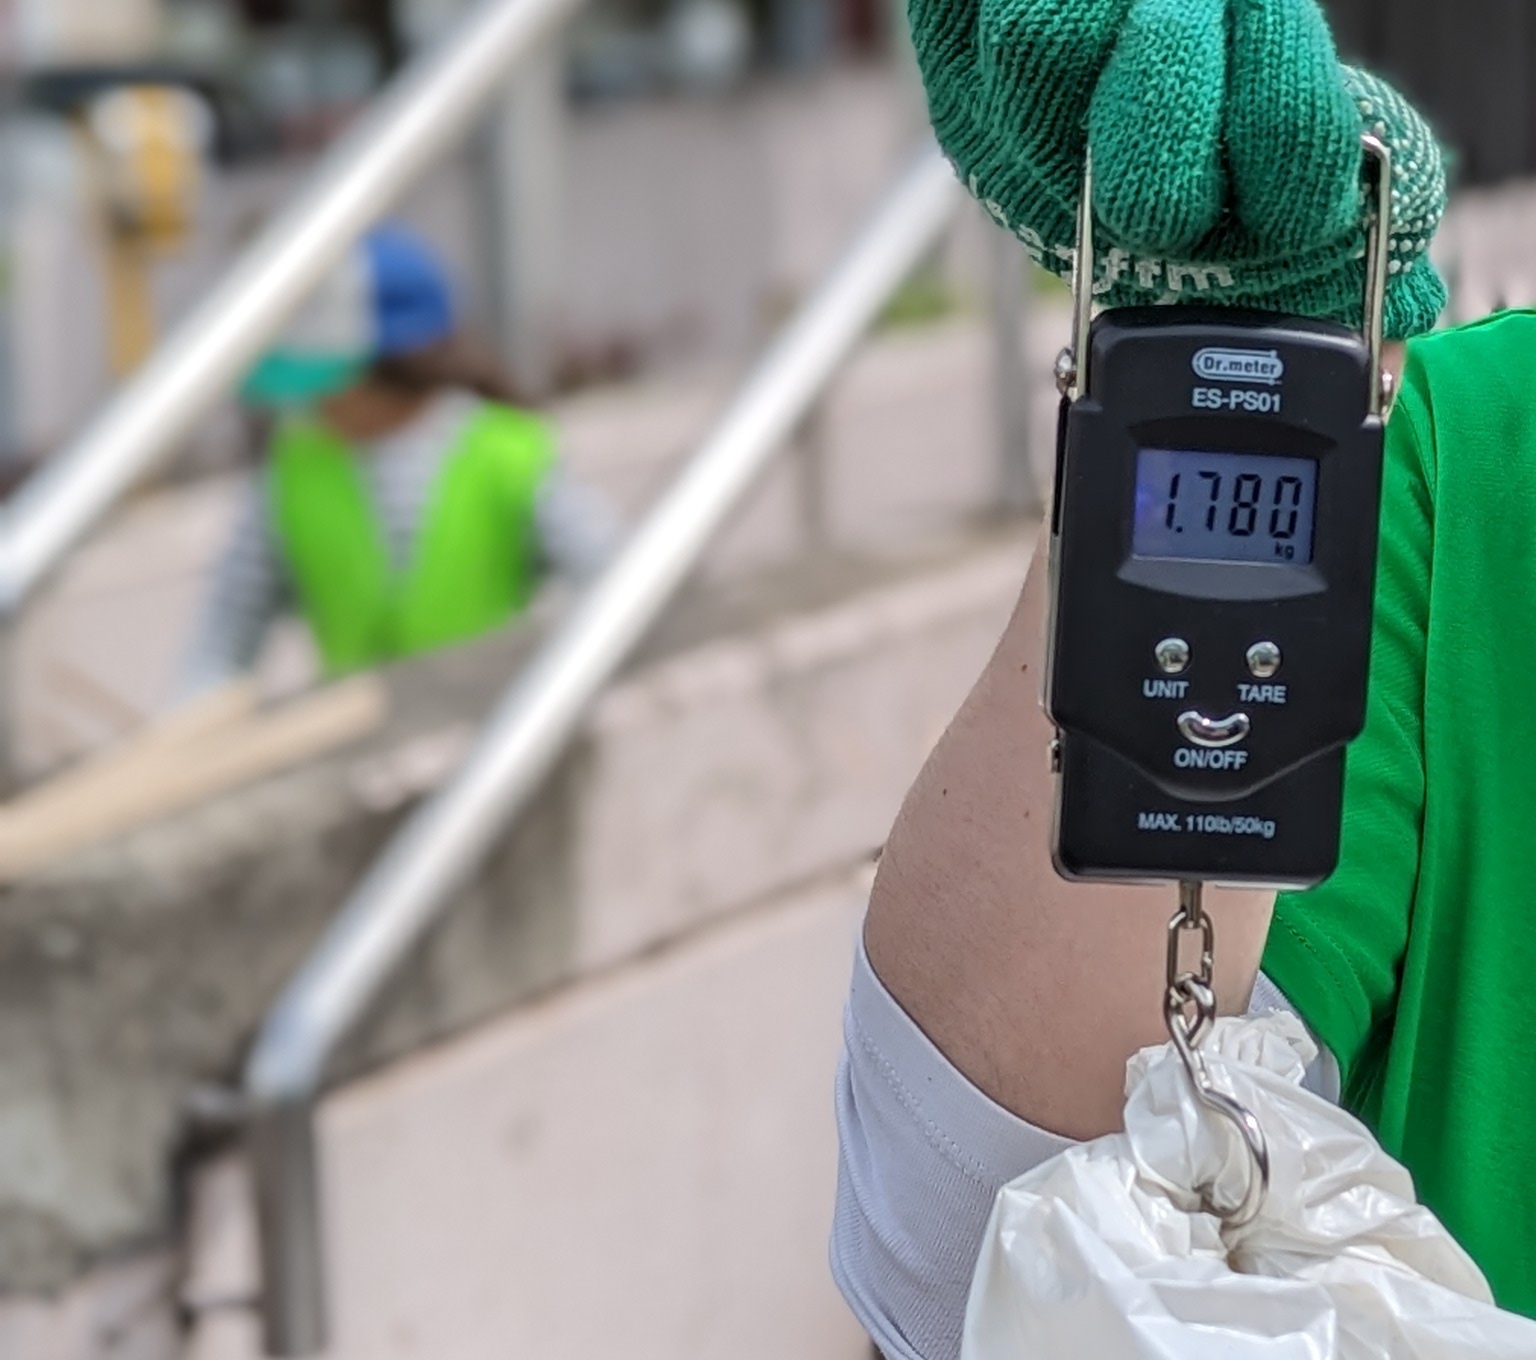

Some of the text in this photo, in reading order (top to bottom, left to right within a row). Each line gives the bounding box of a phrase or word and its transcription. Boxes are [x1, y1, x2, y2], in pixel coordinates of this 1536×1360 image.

[1203, 356, 1278, 375] Dr.meter
[1191, 387, 1281, 412] ES-PS01
[1165, 470, 1302, 539] 1.780
[1143, 679, 1189, 698] UNIT
[1237, 684, 1287, 703] TARE
[1174, 748, 1248, 770] ON/OFF
[1137, 812, 1182, 831] MAX.
